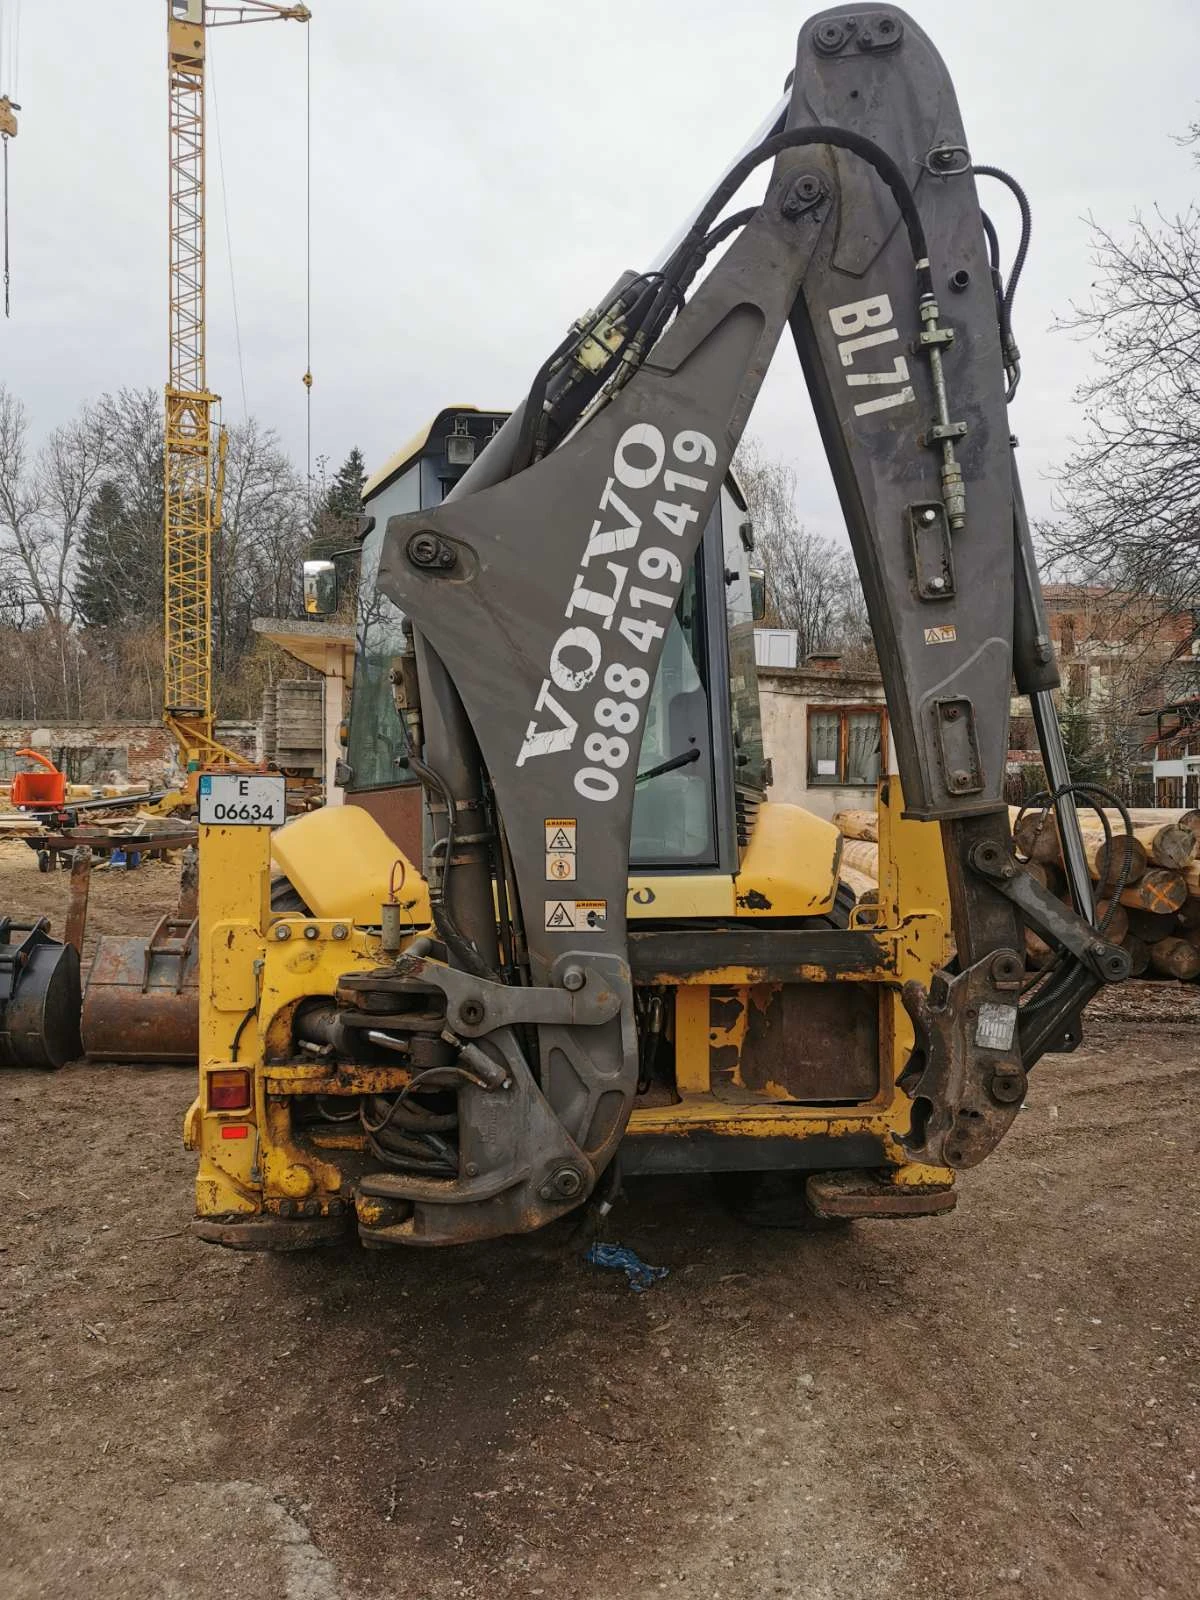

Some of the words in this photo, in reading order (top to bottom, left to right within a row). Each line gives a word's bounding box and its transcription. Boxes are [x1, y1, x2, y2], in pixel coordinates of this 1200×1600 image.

[828, 294, 916, 416] BL71
[516, 423, 665, 767] VOLVO
[574, 663, 649, 801] 0888
[618, 547, 682, 653] 419
[653, 430, 717, 536] 419
[214, 803, 274, 820] 06634
[239, 781, 249, 796] E
